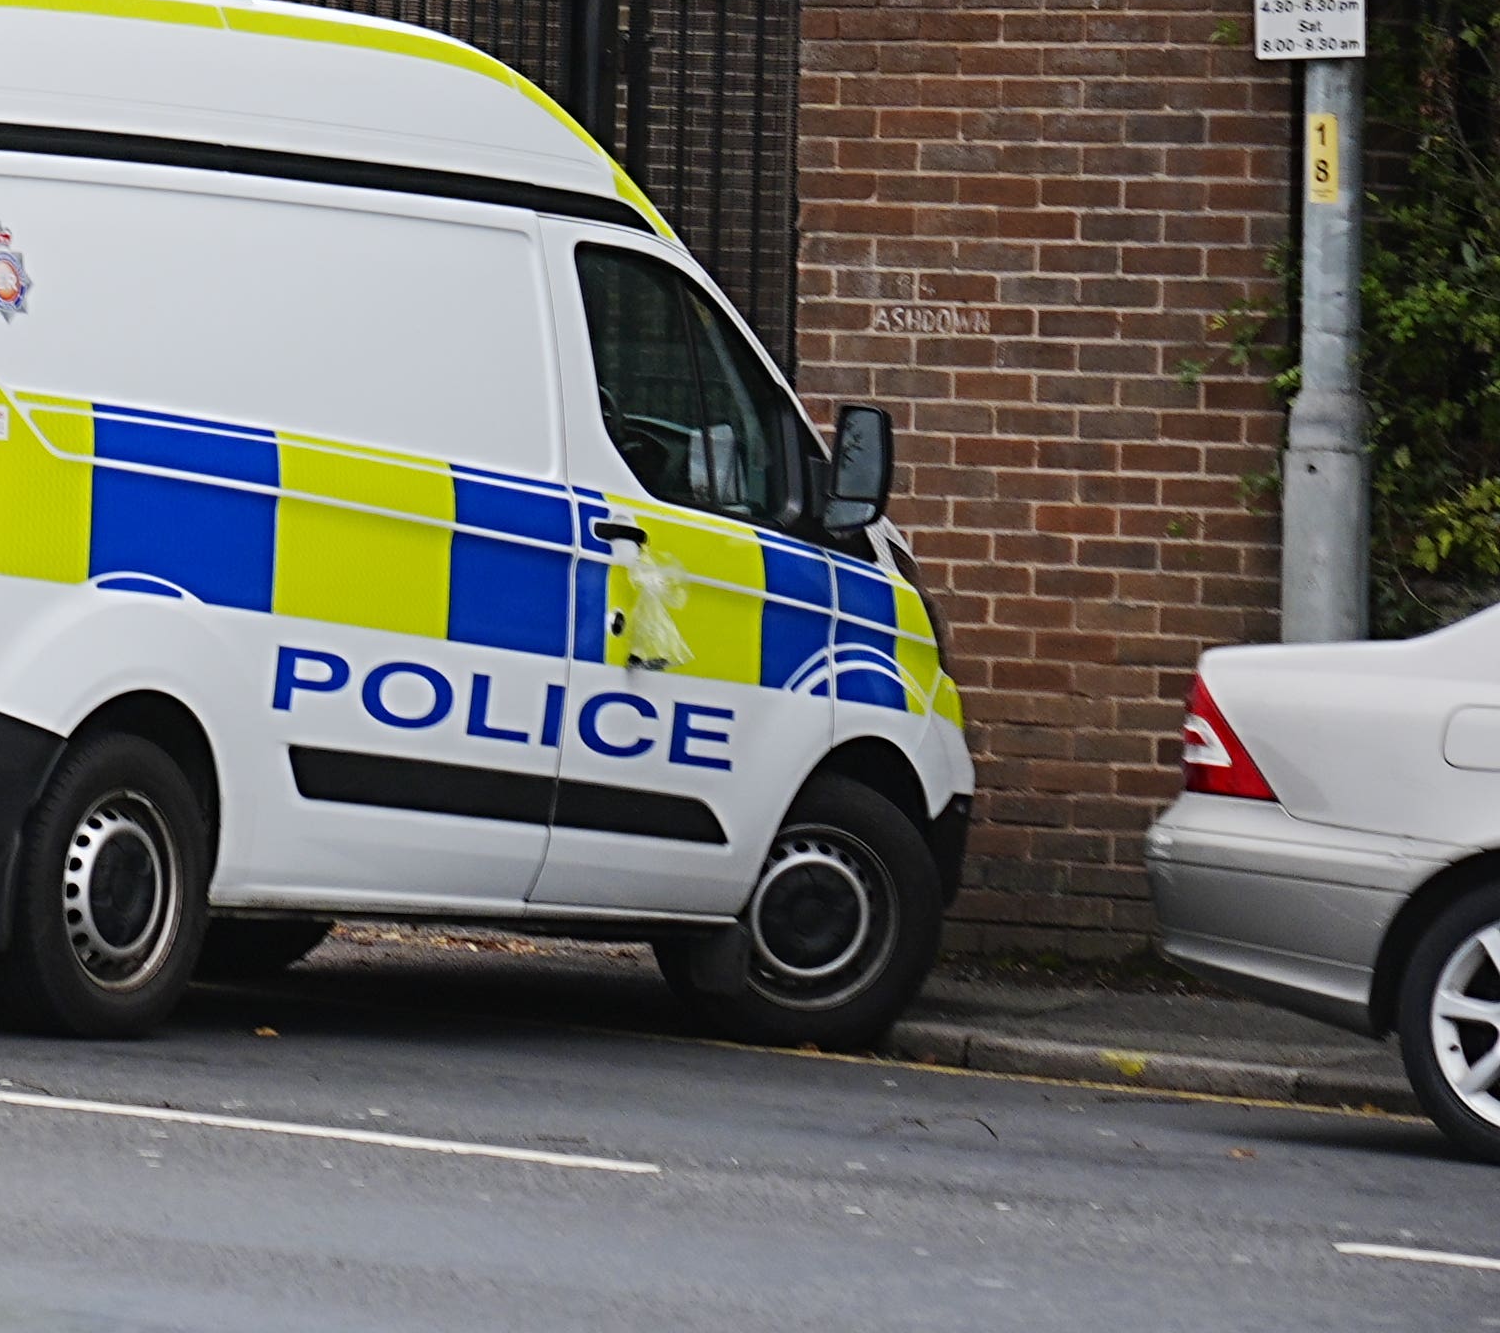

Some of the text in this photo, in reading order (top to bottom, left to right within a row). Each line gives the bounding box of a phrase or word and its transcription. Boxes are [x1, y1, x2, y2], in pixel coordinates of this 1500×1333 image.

[1298, 19, 1323, 33] Sat
[876, 307, 991, 333] ASHDOWN
[271, 645, 735, 772] POLICE
